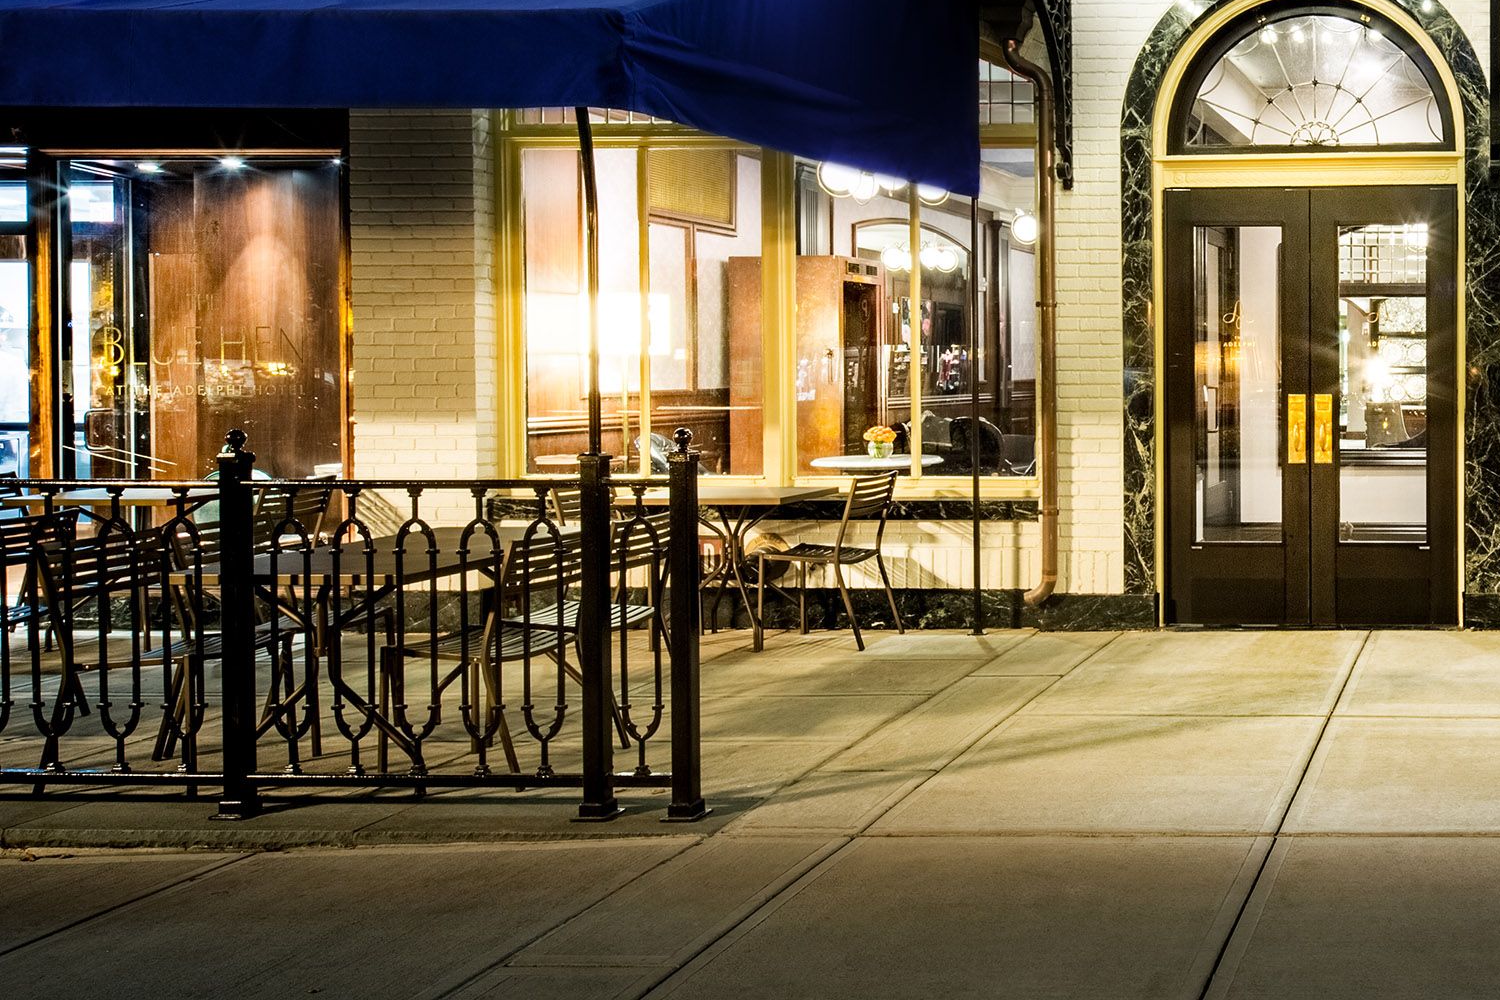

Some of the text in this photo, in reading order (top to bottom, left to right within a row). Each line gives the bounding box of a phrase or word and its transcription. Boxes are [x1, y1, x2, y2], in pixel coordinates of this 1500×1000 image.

[103, 326, 304, 366] BLUE HEN
[105, 384, 306, 396] AT THE ADELPHI HOTEL
